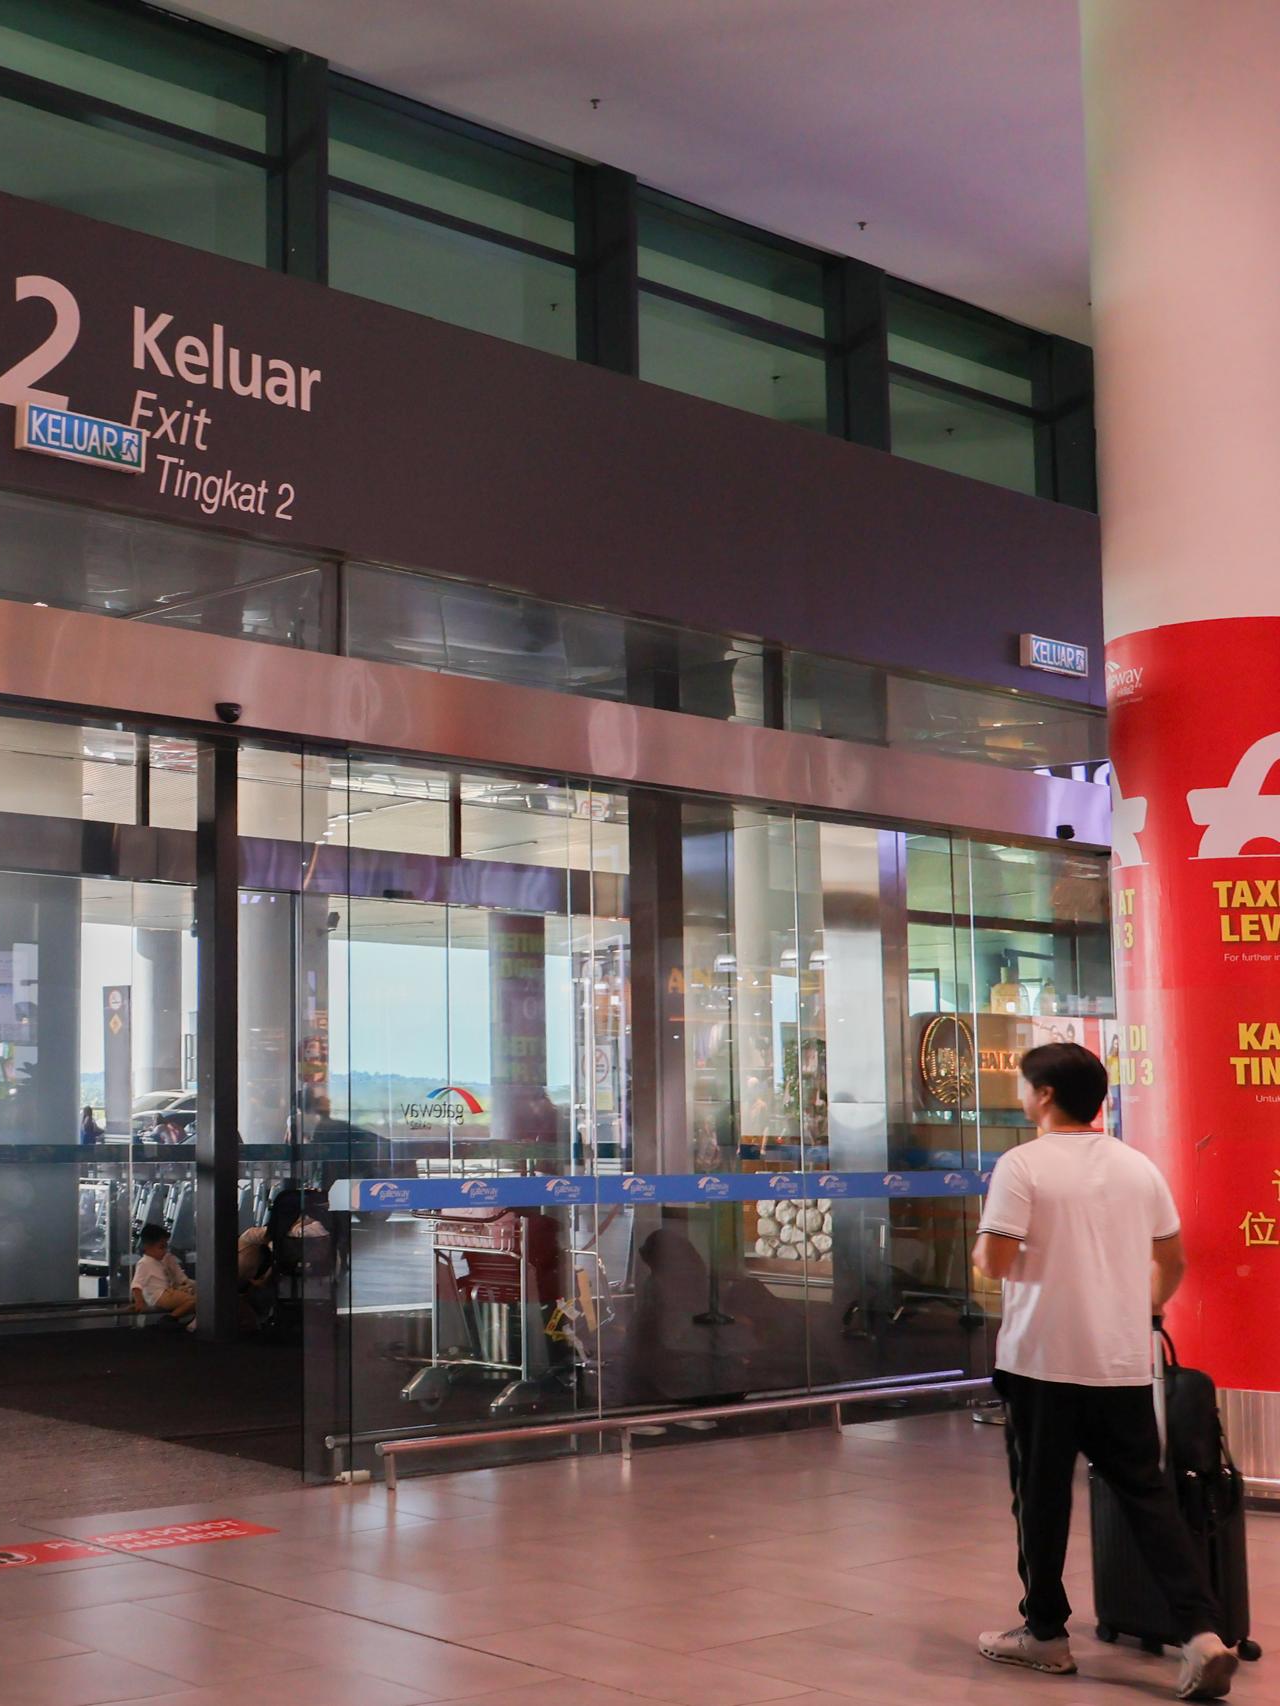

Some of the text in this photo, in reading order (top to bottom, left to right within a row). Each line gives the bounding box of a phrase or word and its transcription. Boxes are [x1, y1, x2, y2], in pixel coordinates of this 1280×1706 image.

[132, 306, 321, 412] Keluar
[31, 406, 118, 458] KELUAR
[130, 390, 212, 451] Exit
[156, 454, 295, 520] Tingkat 2
[1032, 639, 1075, 669] KELUAR
[1213, 880, 1280, 908] TAX
[1124, 922, 1135, 949] 3
[1224, 953, 1239, 962] For
[1242, 952, 1271, 962] further
[1129, 1024, 1147, 1051] DI
[1239, 1022, 1280, 1051] KA
[1140, 1058, 1154, 1086] 3
[1238, 1210, 1280, 1247] 位
[44, 1532, 148, 1550] PLASE
